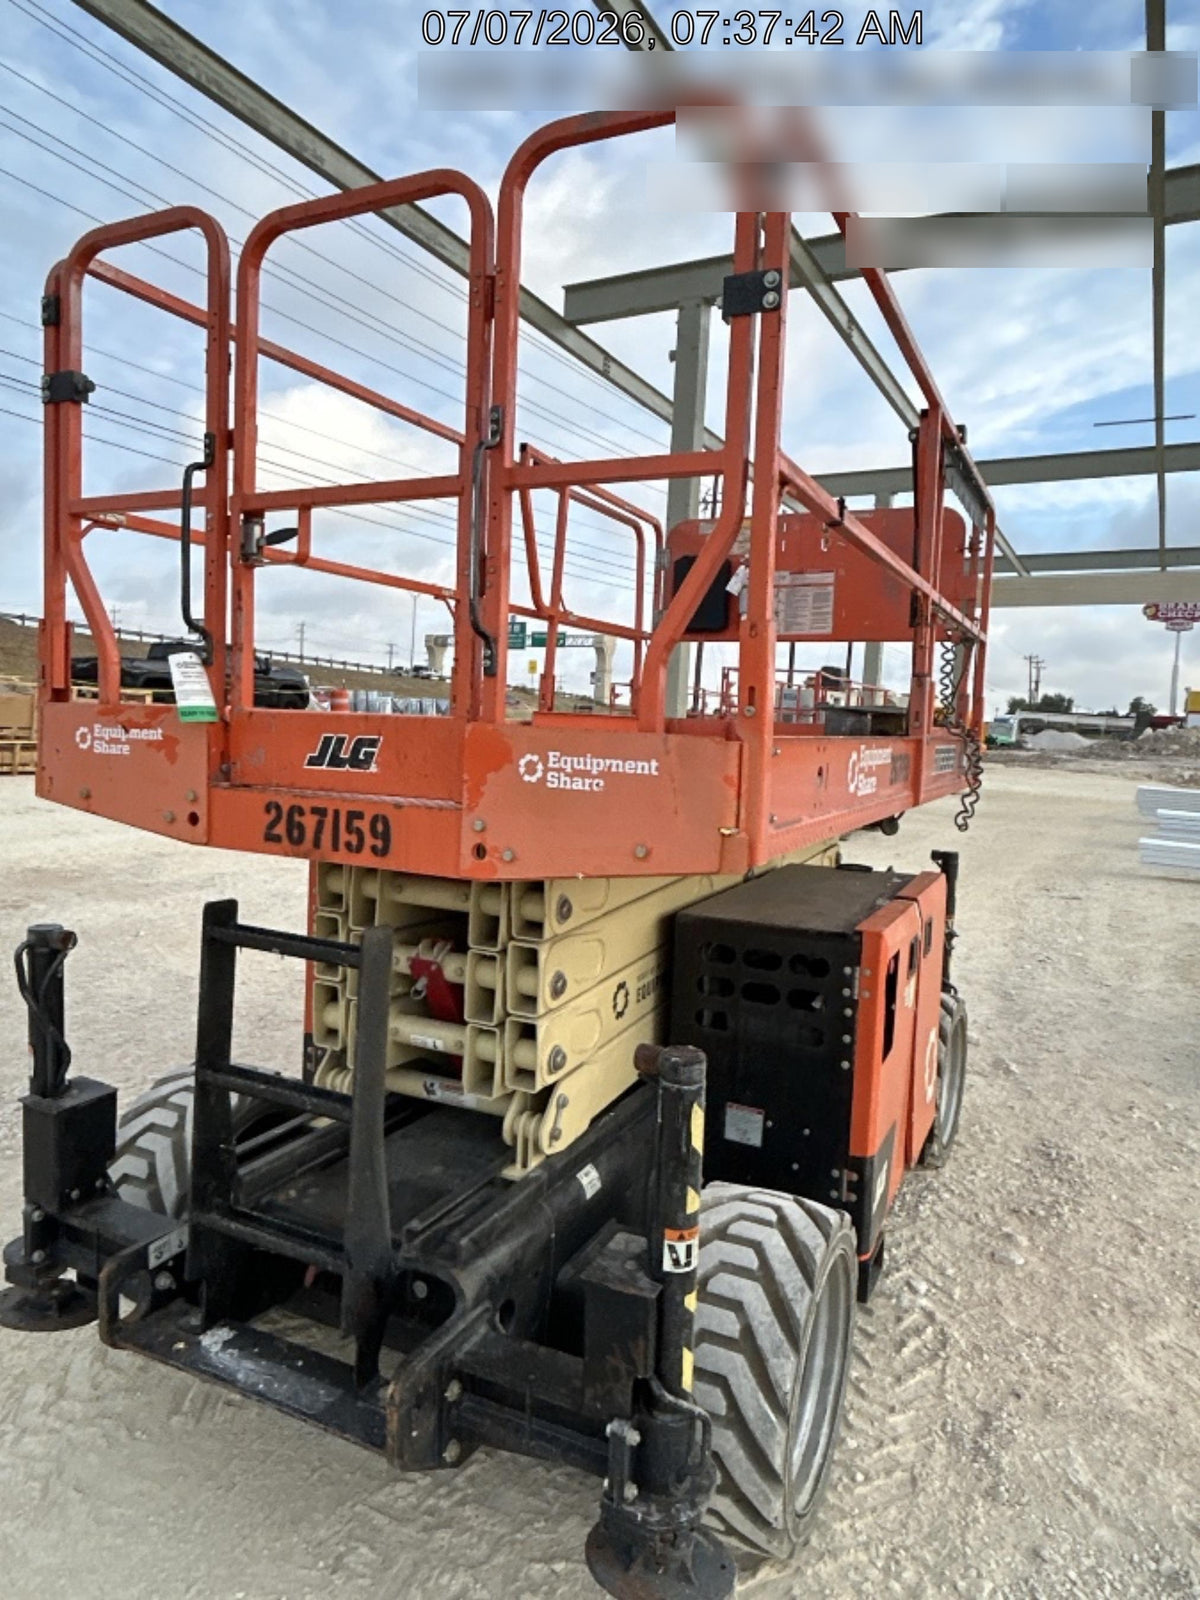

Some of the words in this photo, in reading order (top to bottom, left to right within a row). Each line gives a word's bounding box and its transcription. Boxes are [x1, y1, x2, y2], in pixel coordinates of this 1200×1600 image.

[93, 724, 163, 741] Equipment
[93, 740, 131, 755] Share
[303, 734, 383, 772] JLG
[547, 751, 659, 776] Equipment
[546, 771, 605, 792] Share
[263, 800, 392, 858] 267159
